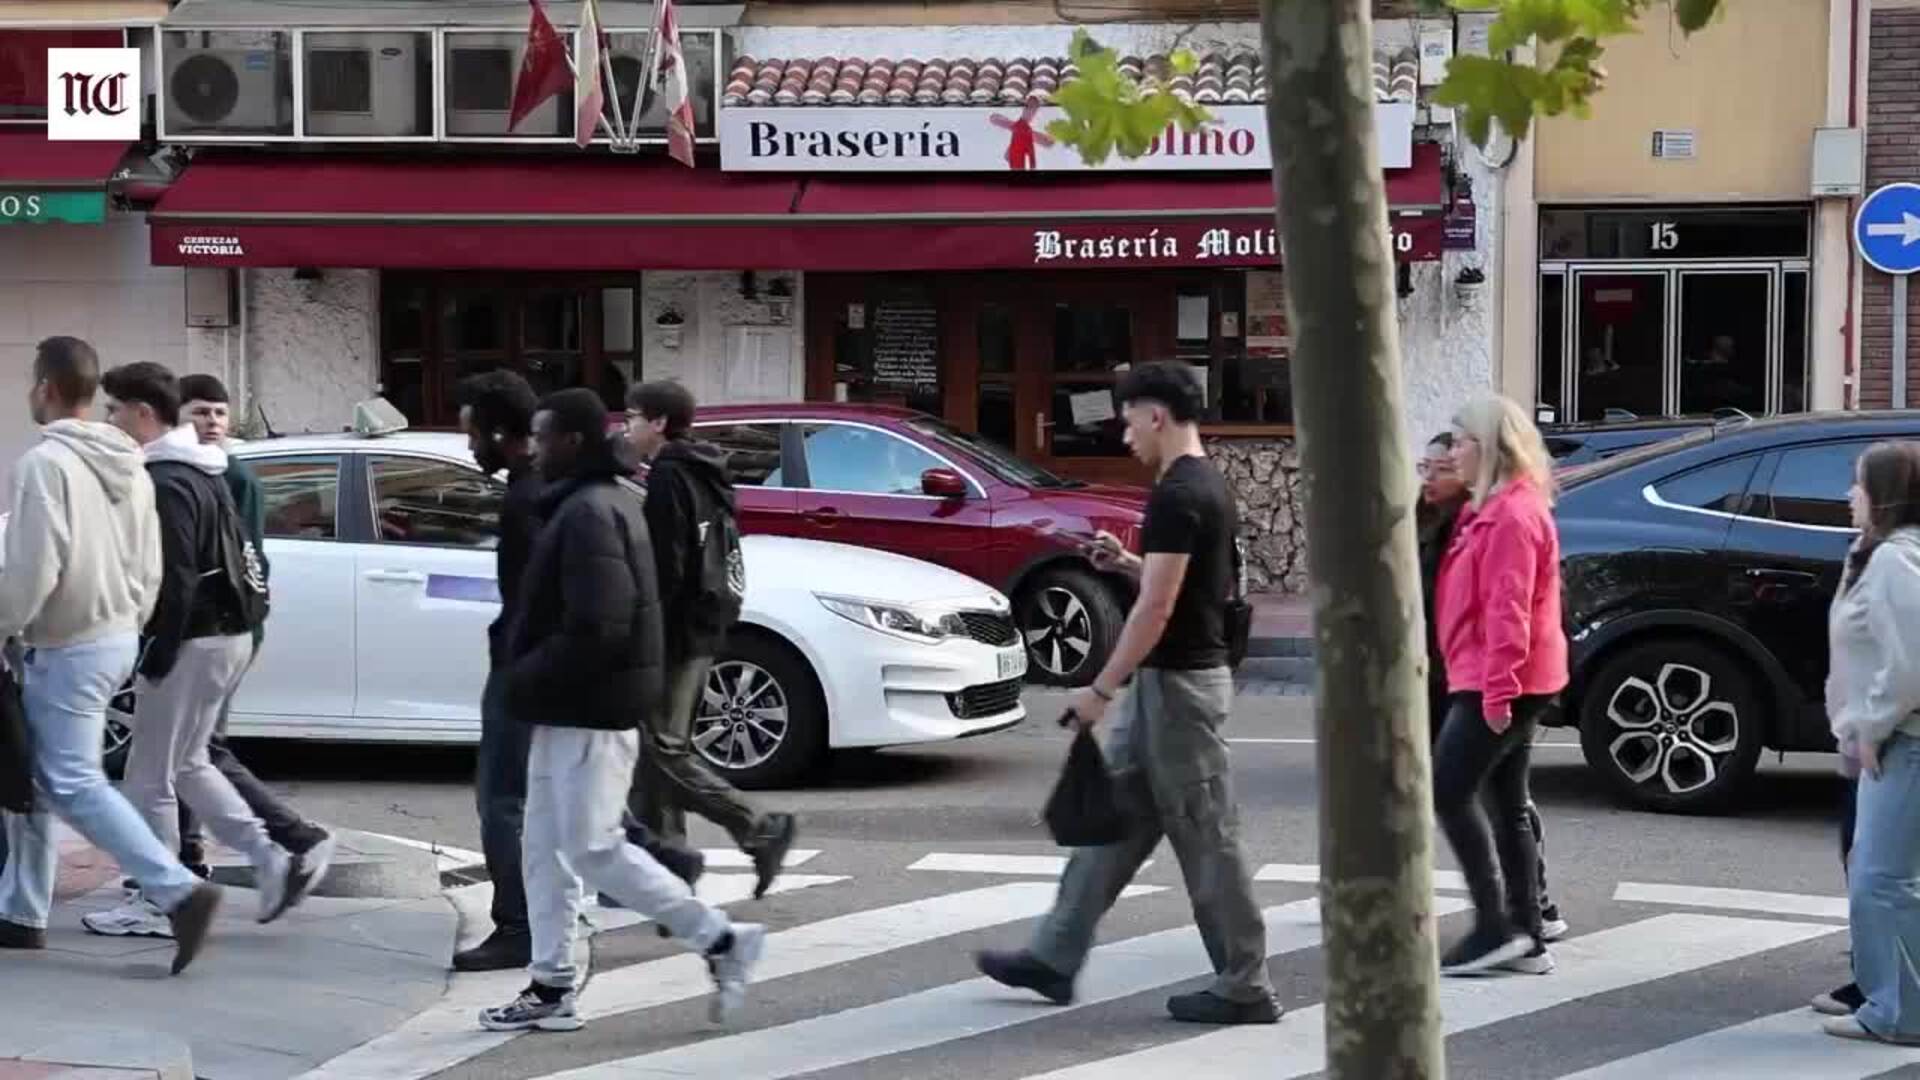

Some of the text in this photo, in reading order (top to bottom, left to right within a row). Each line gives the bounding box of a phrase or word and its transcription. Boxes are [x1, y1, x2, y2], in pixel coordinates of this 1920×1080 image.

[750, 120, 1255, 158] Brasería lino
[1, 196, 40, 216] OS
[179, 244, 244, 255] VICTORIA
[1034, 228, 1276, 262] Brasería Moli
[1651, 222, 1679, 250] 15
